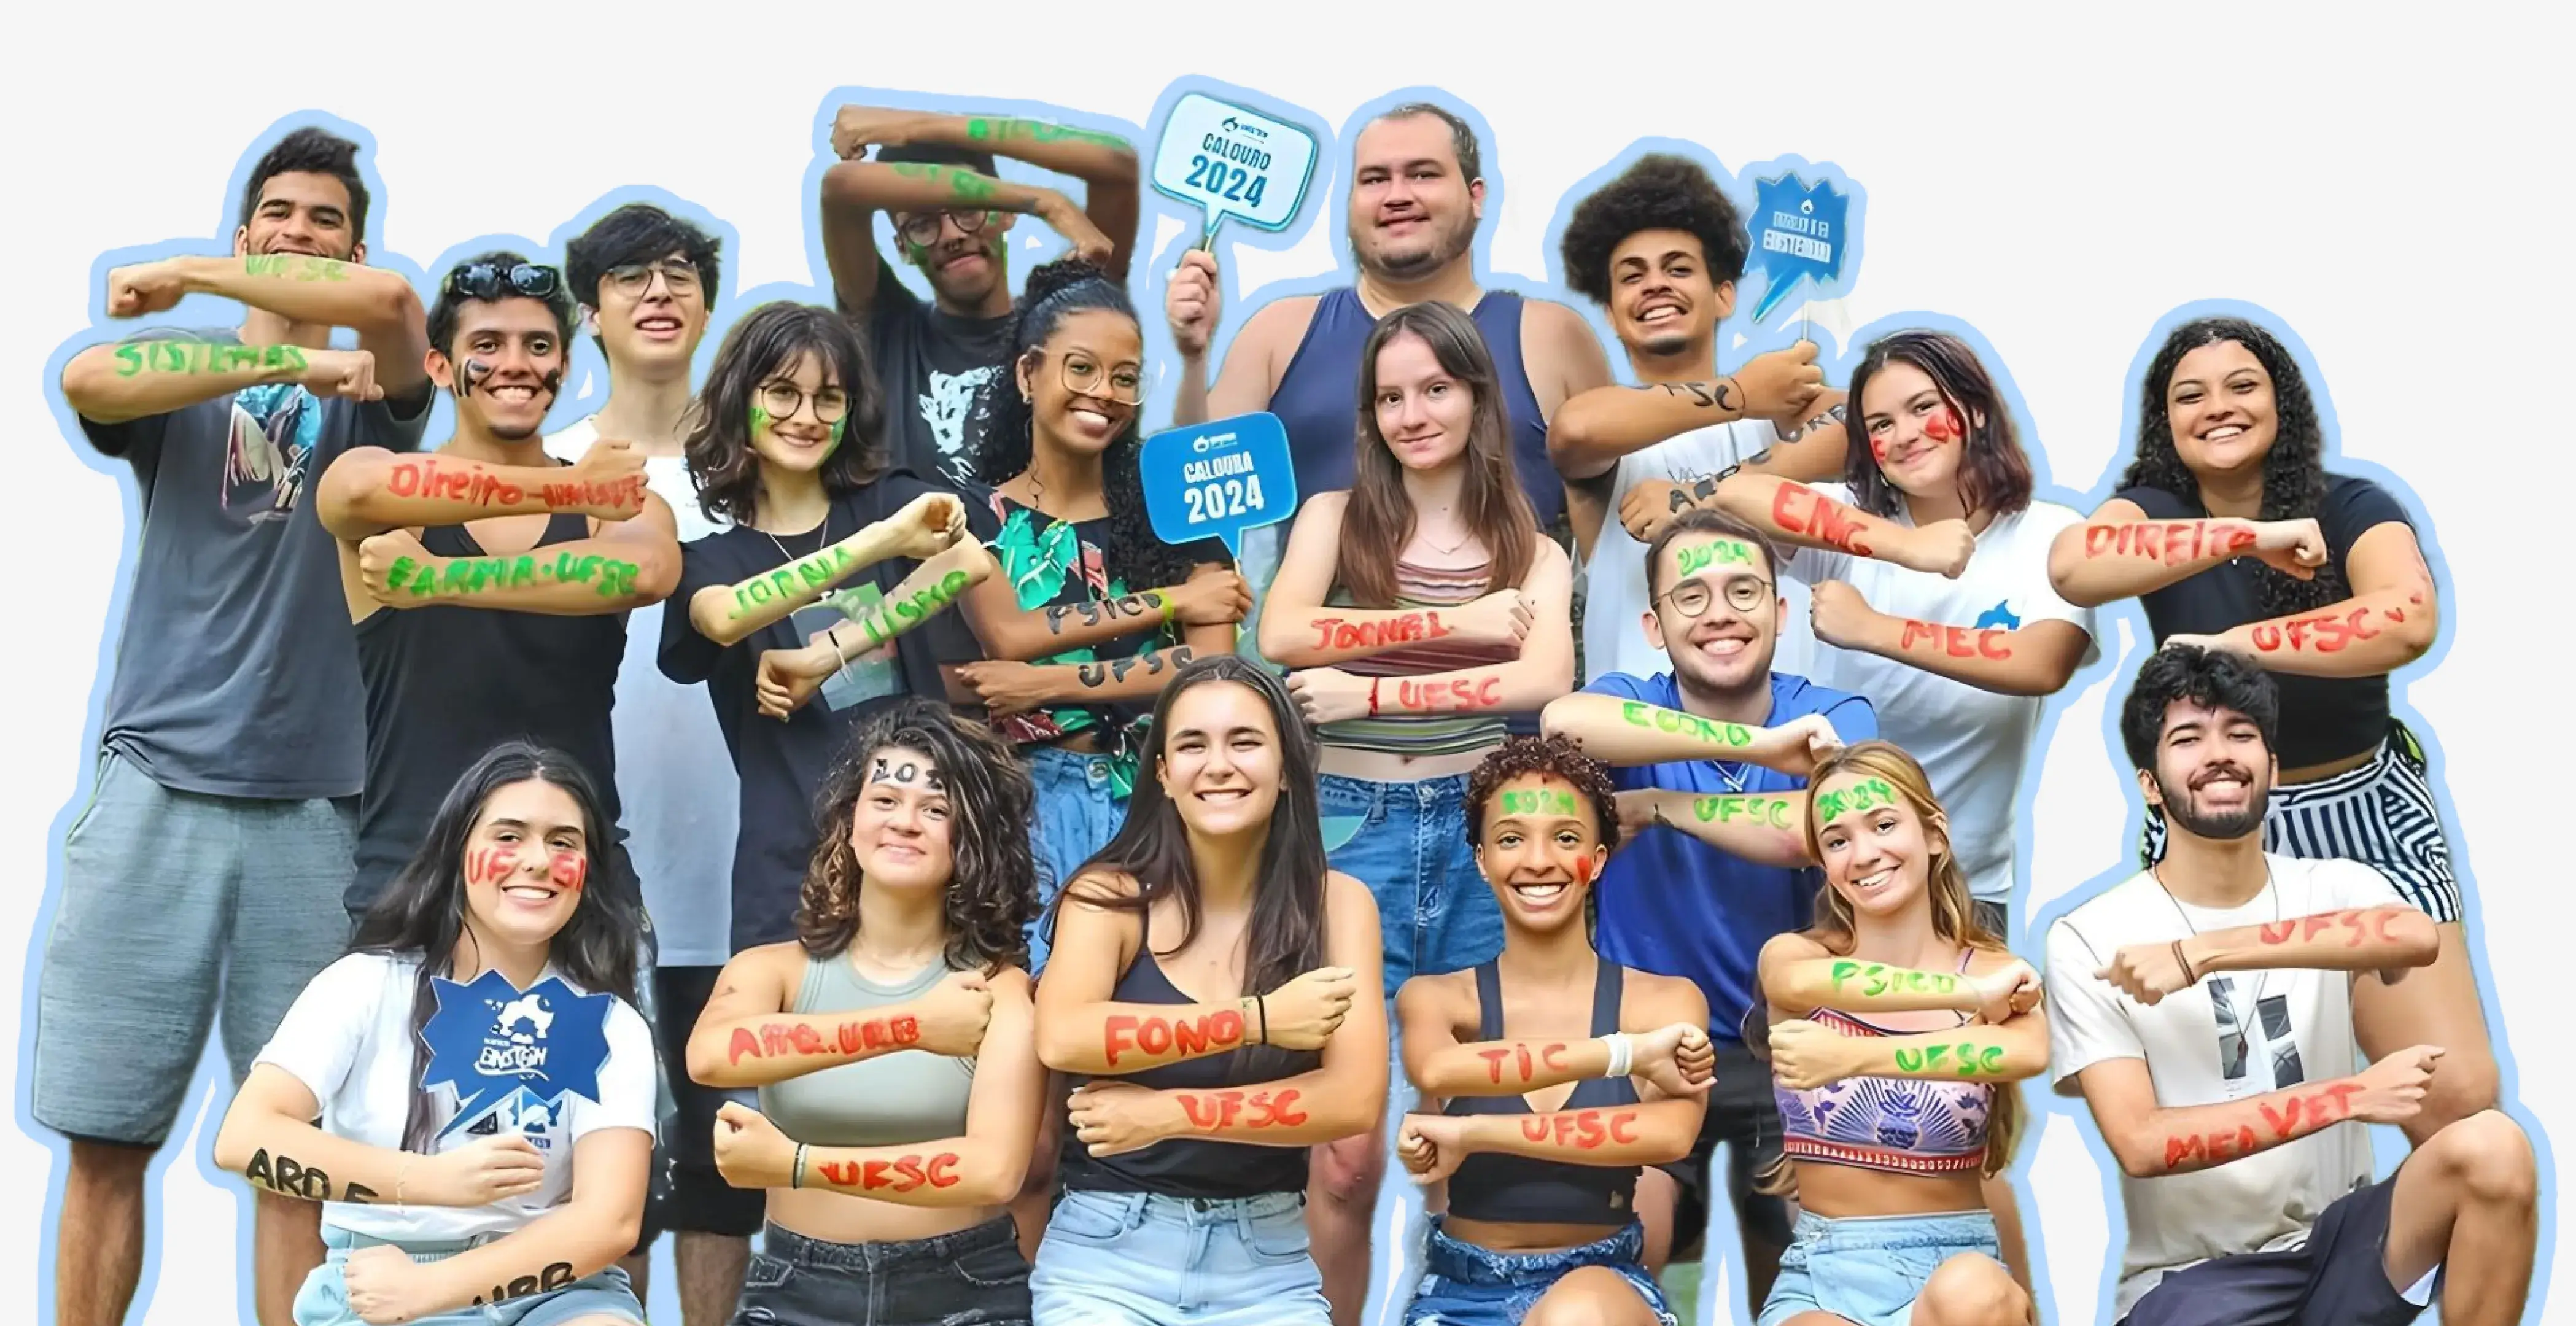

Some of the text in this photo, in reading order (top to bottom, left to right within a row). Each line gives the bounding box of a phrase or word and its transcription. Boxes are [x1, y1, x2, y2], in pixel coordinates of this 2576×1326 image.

[1202, 133, 1271, 171] CALOURO
[1185, 154, 1268, 208] 2024
[1184, 451, 1254, 483] CALOURA
[1184, 474, 1265, 524] 2024
[2085, 522, 2257, 566] DIREITO
[1900, 619, 2013, 661] MEC
[2253, 607, 2381, 654] UFSC
[1078, 646, 1192, 688] UFSC
[1399, 677, 1502, 712] UFSC
[1693, 794, 1791, 829] UFSC
[2259, 911, 2400, 947] UFSC
[1105, 1010, 1244, 1068] FONO
[1895, 1041, 2006, 1076] UFSC
[1478, 1043, 1569, 1085] TIC
[1177, 1088, 1310, 1132] UFSC
[1521, 1109, 1639, 1150] UFSC
[2259, 1083, 2366, 1138] VET
